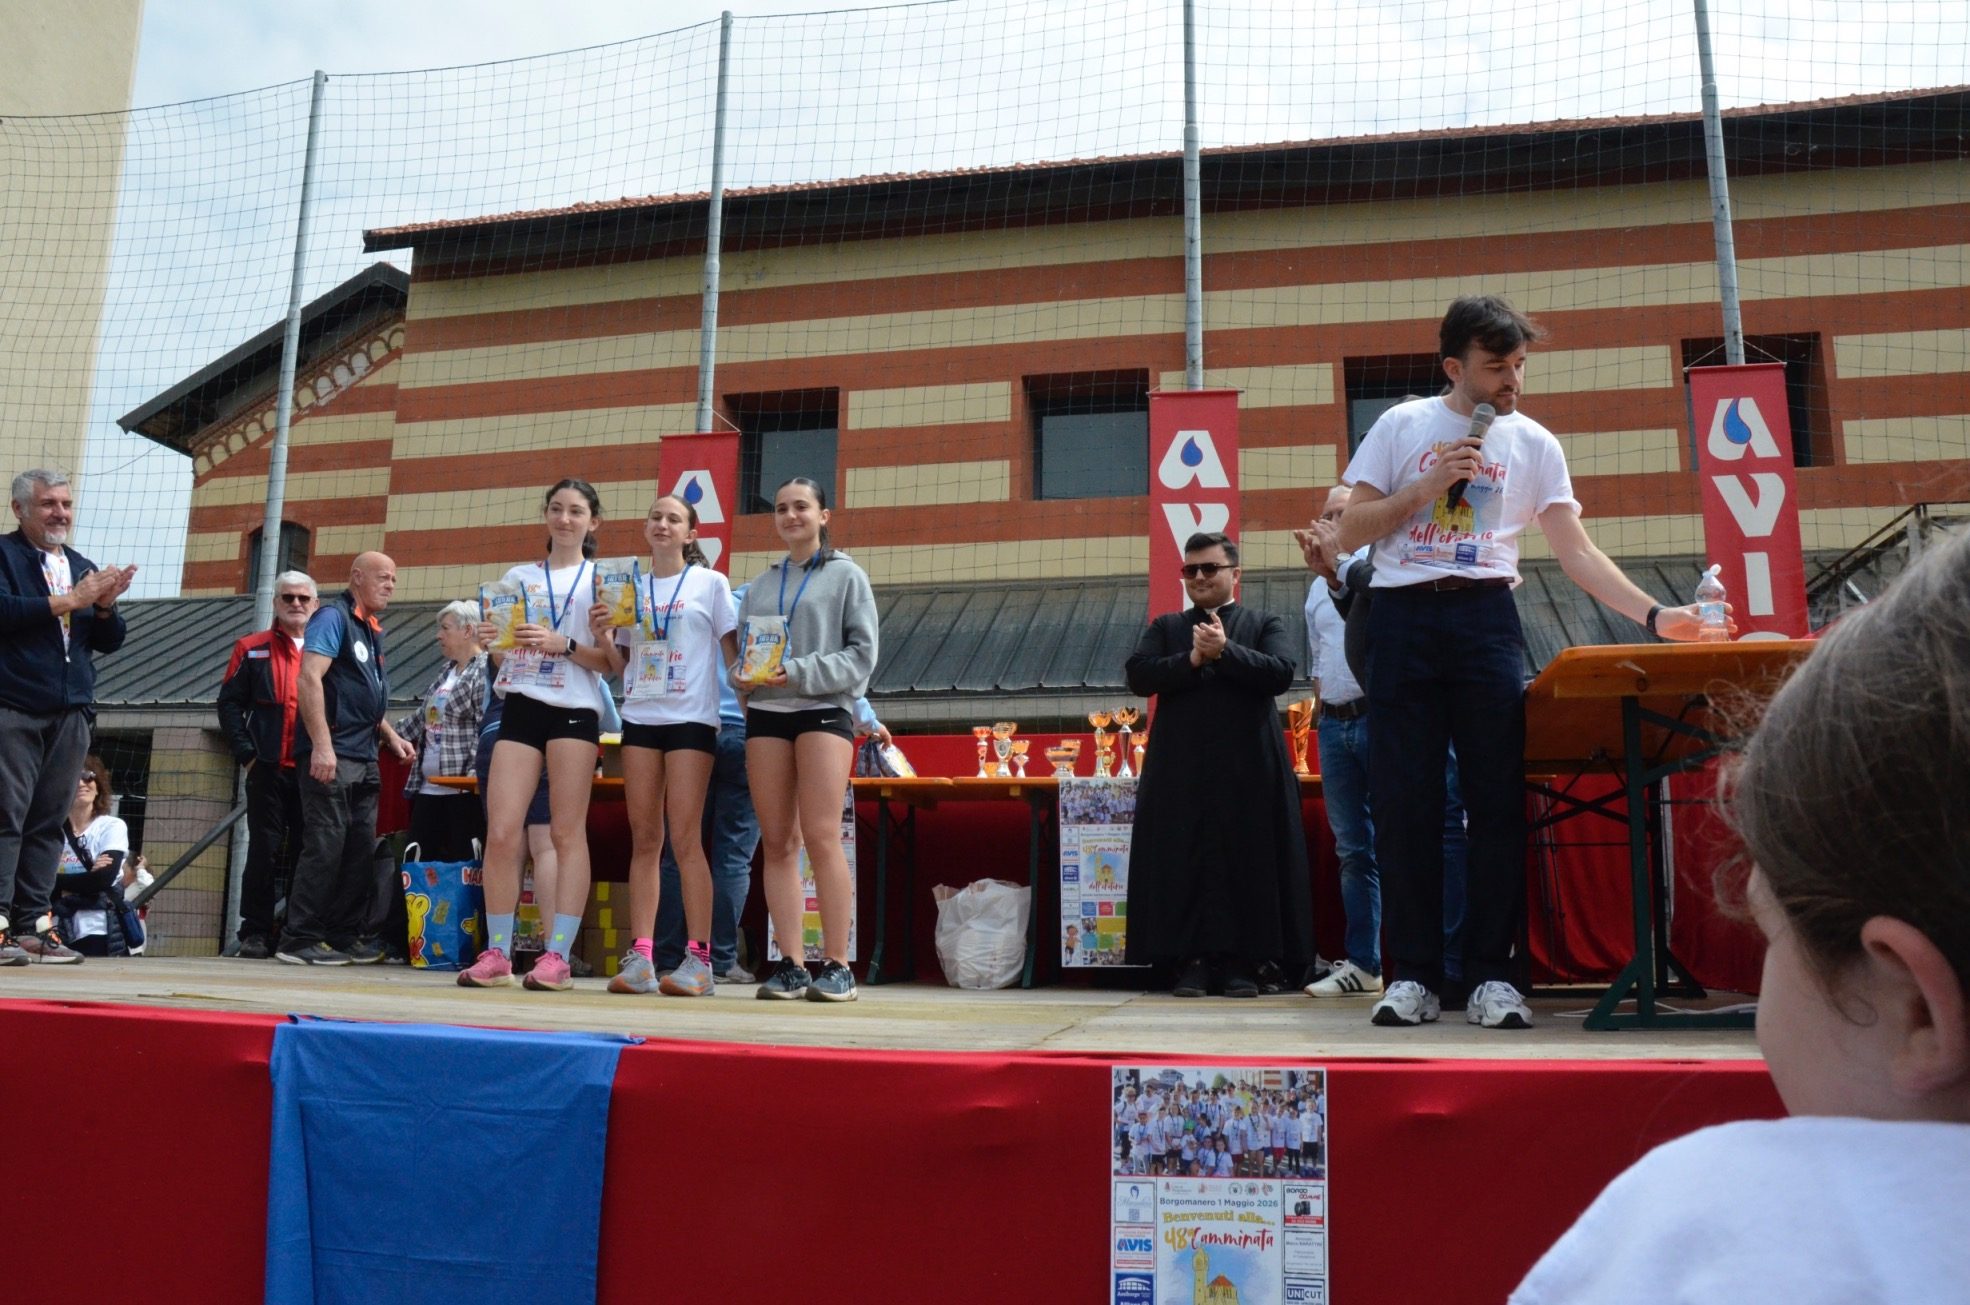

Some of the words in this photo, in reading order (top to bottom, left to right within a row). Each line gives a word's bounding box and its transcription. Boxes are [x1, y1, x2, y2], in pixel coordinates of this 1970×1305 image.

[1158, 430, 1231, 612] AV
[1707, 397, 1790, 641] AVI
[1160, 1198, 1216, 1207] Borgomanero
[1224, 1199, 1255, 1208] Maggio
[1163, 1210, 1234, 1223] Benvenuti
[1117, 1238, 1153, 1252] AVIS
[1191, 1227, 1274, 1251] Camminata
[1287, 1288, 1322, 1300] UNICUT
